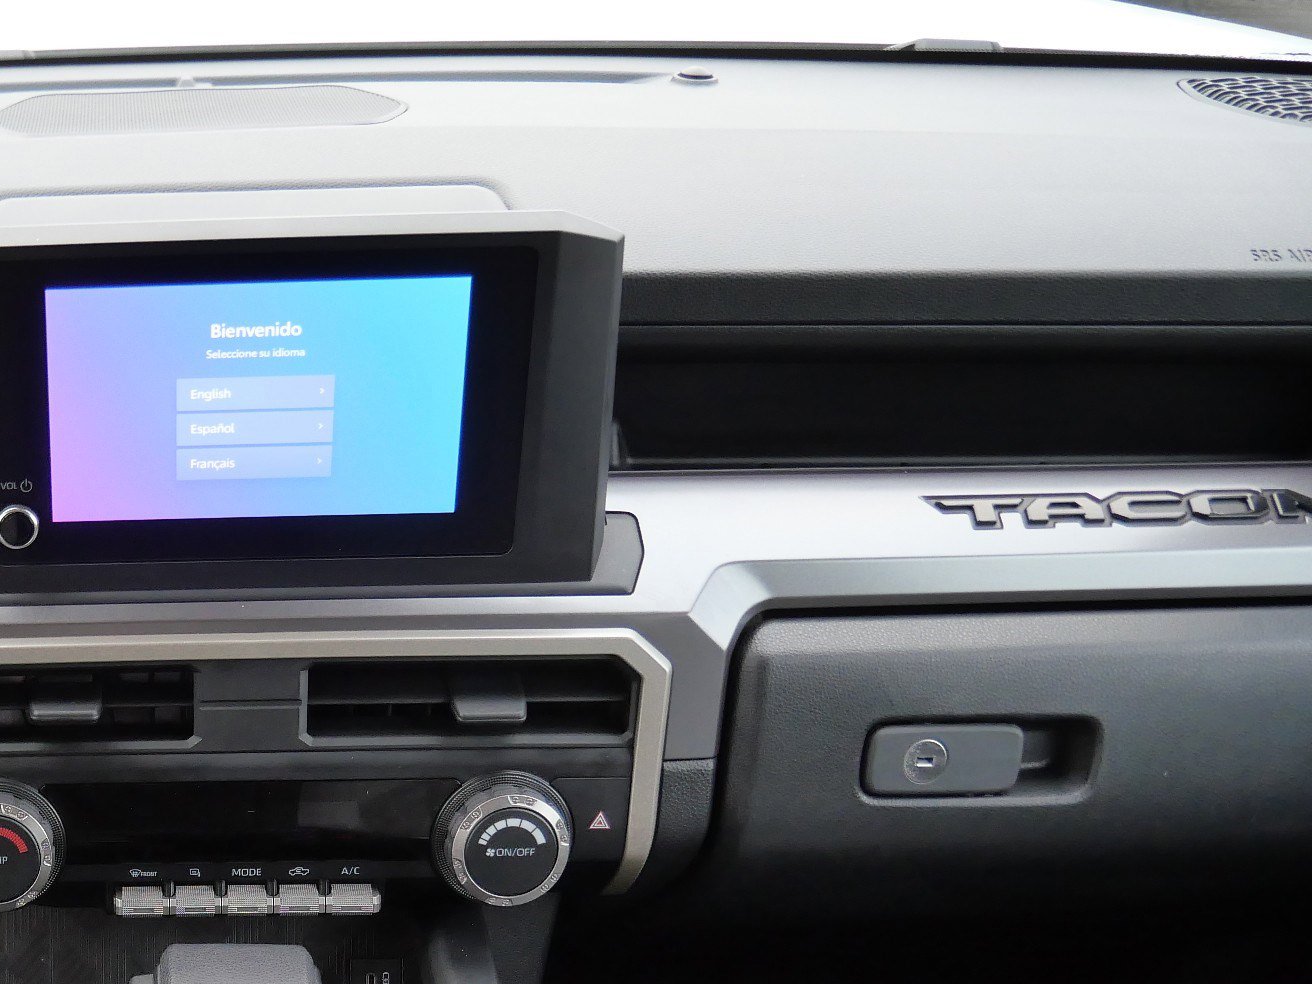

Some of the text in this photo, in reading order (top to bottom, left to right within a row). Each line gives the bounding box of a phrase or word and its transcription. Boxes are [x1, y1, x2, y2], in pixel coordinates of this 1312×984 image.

[209, 321, 303, 339] Bienvenido
[205, 347, 306, 360] Seleccione su idioma
[190, 388, 232, 401] English
[190, 423, 235, 436] Español
[190, 457, 236, 470] Français
[0, 482, 18, 490] VOL
[496, 847, 536, 857] ON/OFF
[231, 867, 261, 877] MODE
[340, 866, 360, 876] A/C
